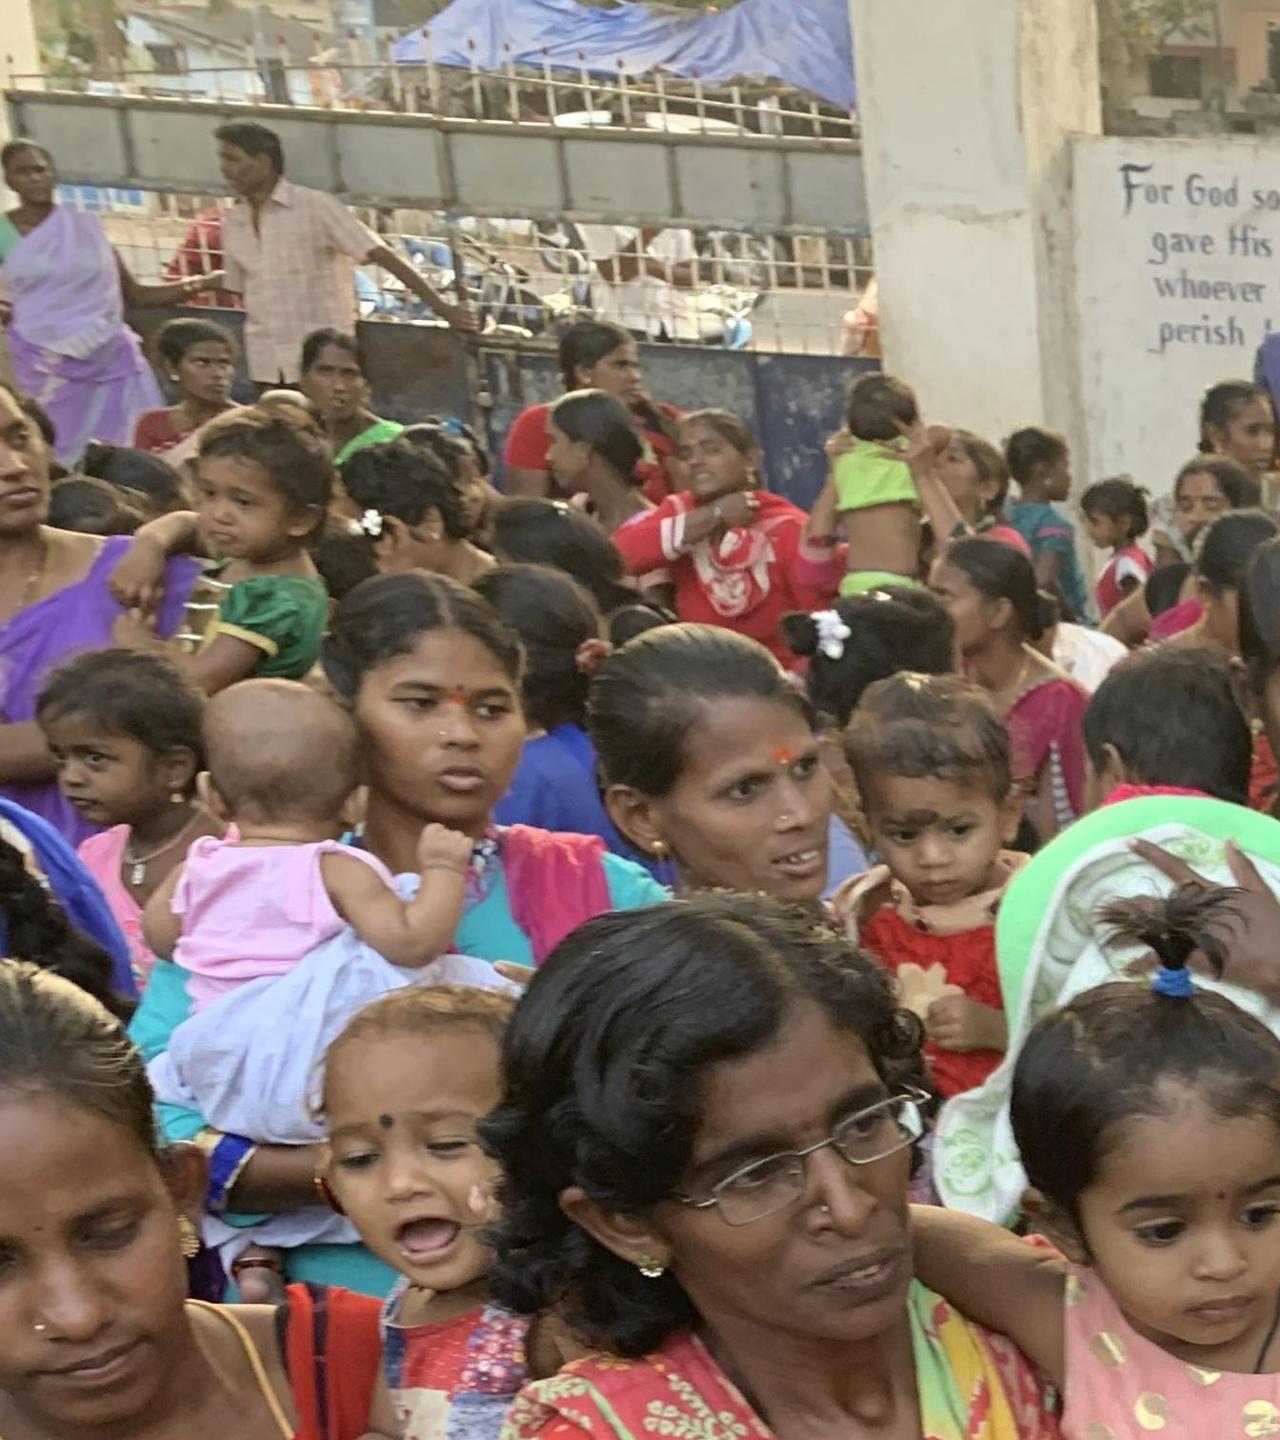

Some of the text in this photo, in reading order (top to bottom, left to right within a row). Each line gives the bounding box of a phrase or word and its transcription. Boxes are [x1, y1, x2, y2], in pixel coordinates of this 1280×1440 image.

[1120, 164, 1174, 218] For
[1185, 173, 1239, 208] God
[1148, 231, 1214, 265] gave
[1227, 223, 1272, 257] His
[1153, 269, 1266, 303] whoever
[1147, 314, 1245, 354] perish
